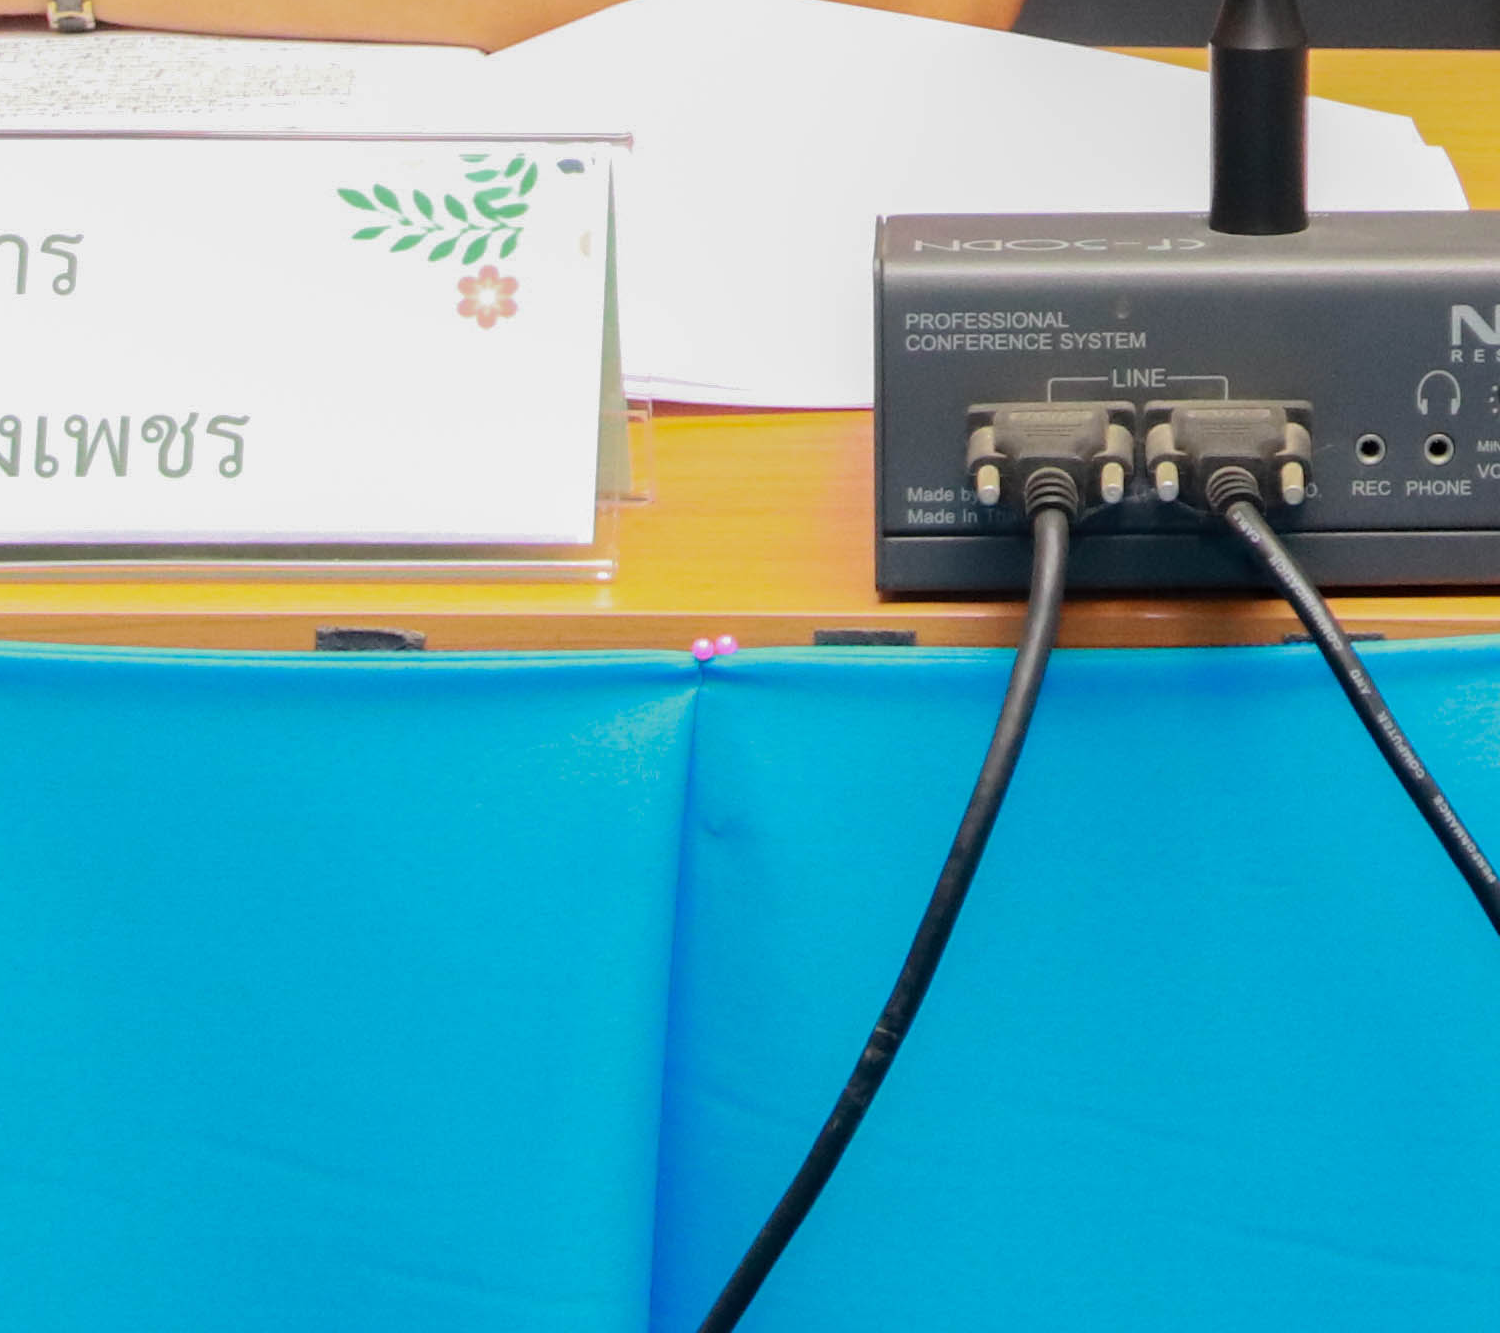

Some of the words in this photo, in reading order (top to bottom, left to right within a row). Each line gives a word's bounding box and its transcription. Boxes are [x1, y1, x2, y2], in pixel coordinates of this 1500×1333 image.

[904, 311, 1070, 331] PROFESSIONAL
[904, 332, 1053, 351] CONFERENCE
[1059, 331, 1147, 350] SYSTEM
[1111, 367, 1168, 389] LINE
[907, 487, 955, 503] Made
[1351, 480, 1392, 497] REC
[1405, 479, 1473, 497] PHONE
[907, 508, 957, 525] Made
[1268, 553, 1345, 652] COMMUNICATION
[1349, 668, 1372, 696] AND
[1376, 708, 1426, 780] COMPUTER
[1434, 796, 1498, 885] PERFORMANCE
